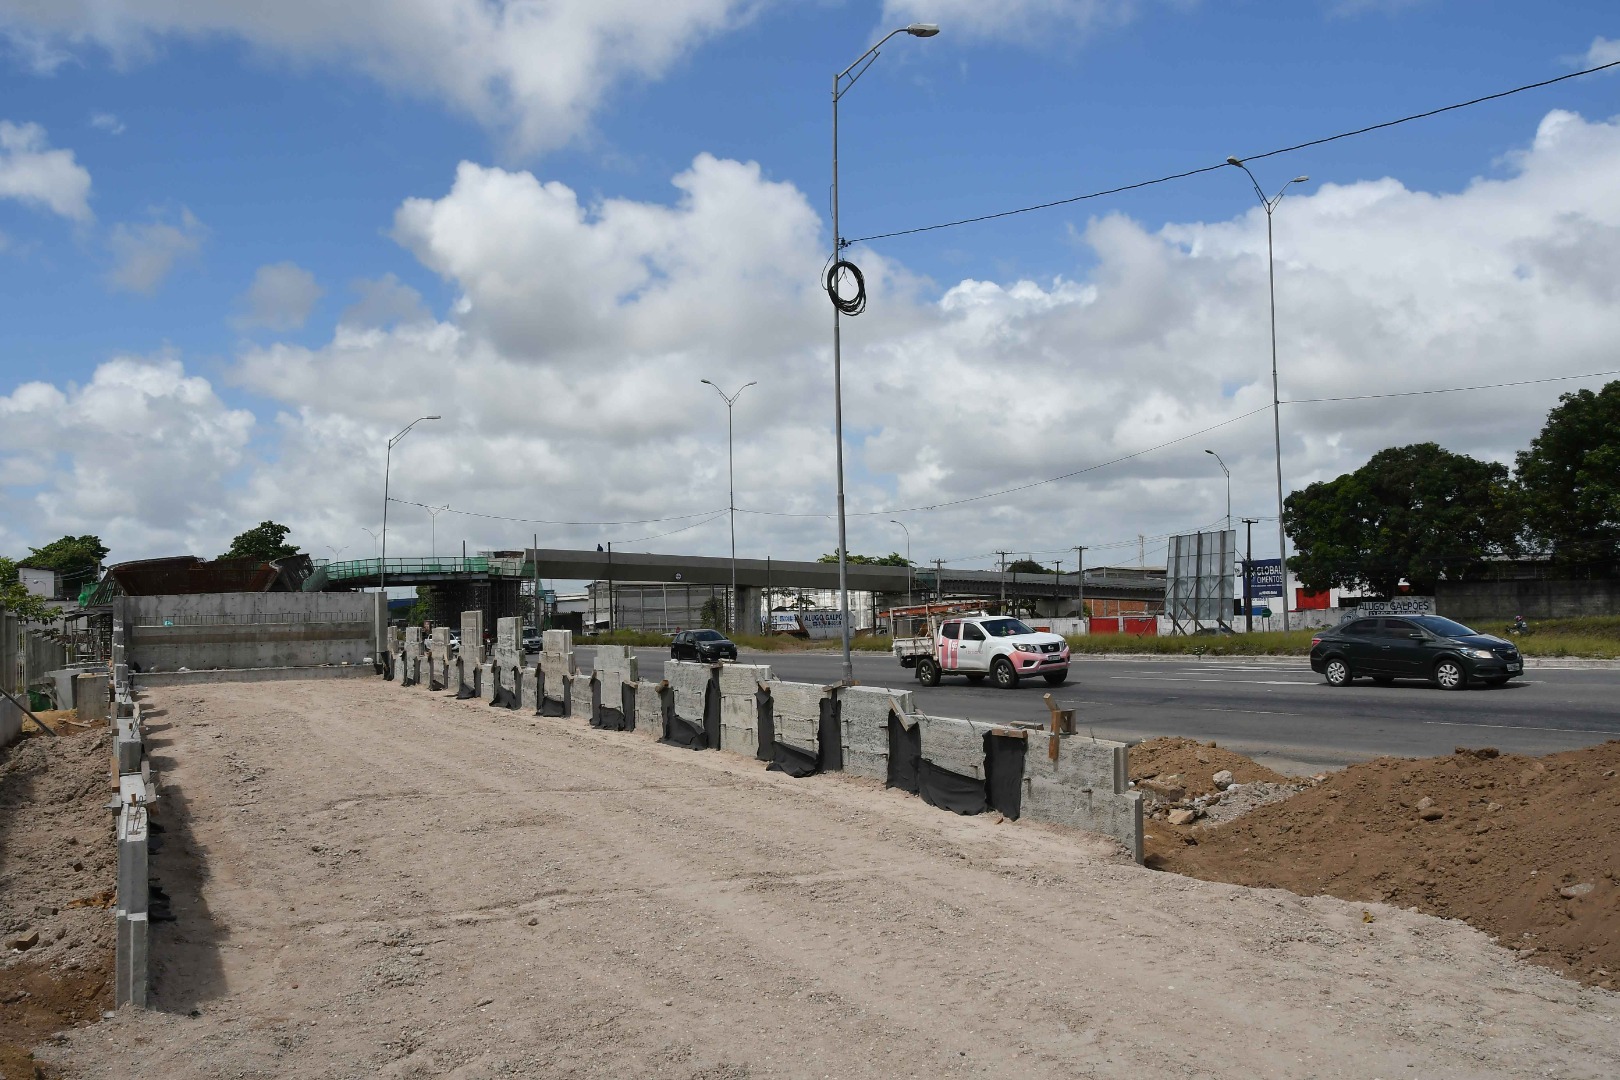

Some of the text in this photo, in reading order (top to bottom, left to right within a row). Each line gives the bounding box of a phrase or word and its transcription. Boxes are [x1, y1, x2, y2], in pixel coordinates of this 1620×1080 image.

[1256, 566, 1281, 575] GLOBAL
[1359, 602, 1385, 611] ALUGO
[804, 614, 824, 622] ALUGO
